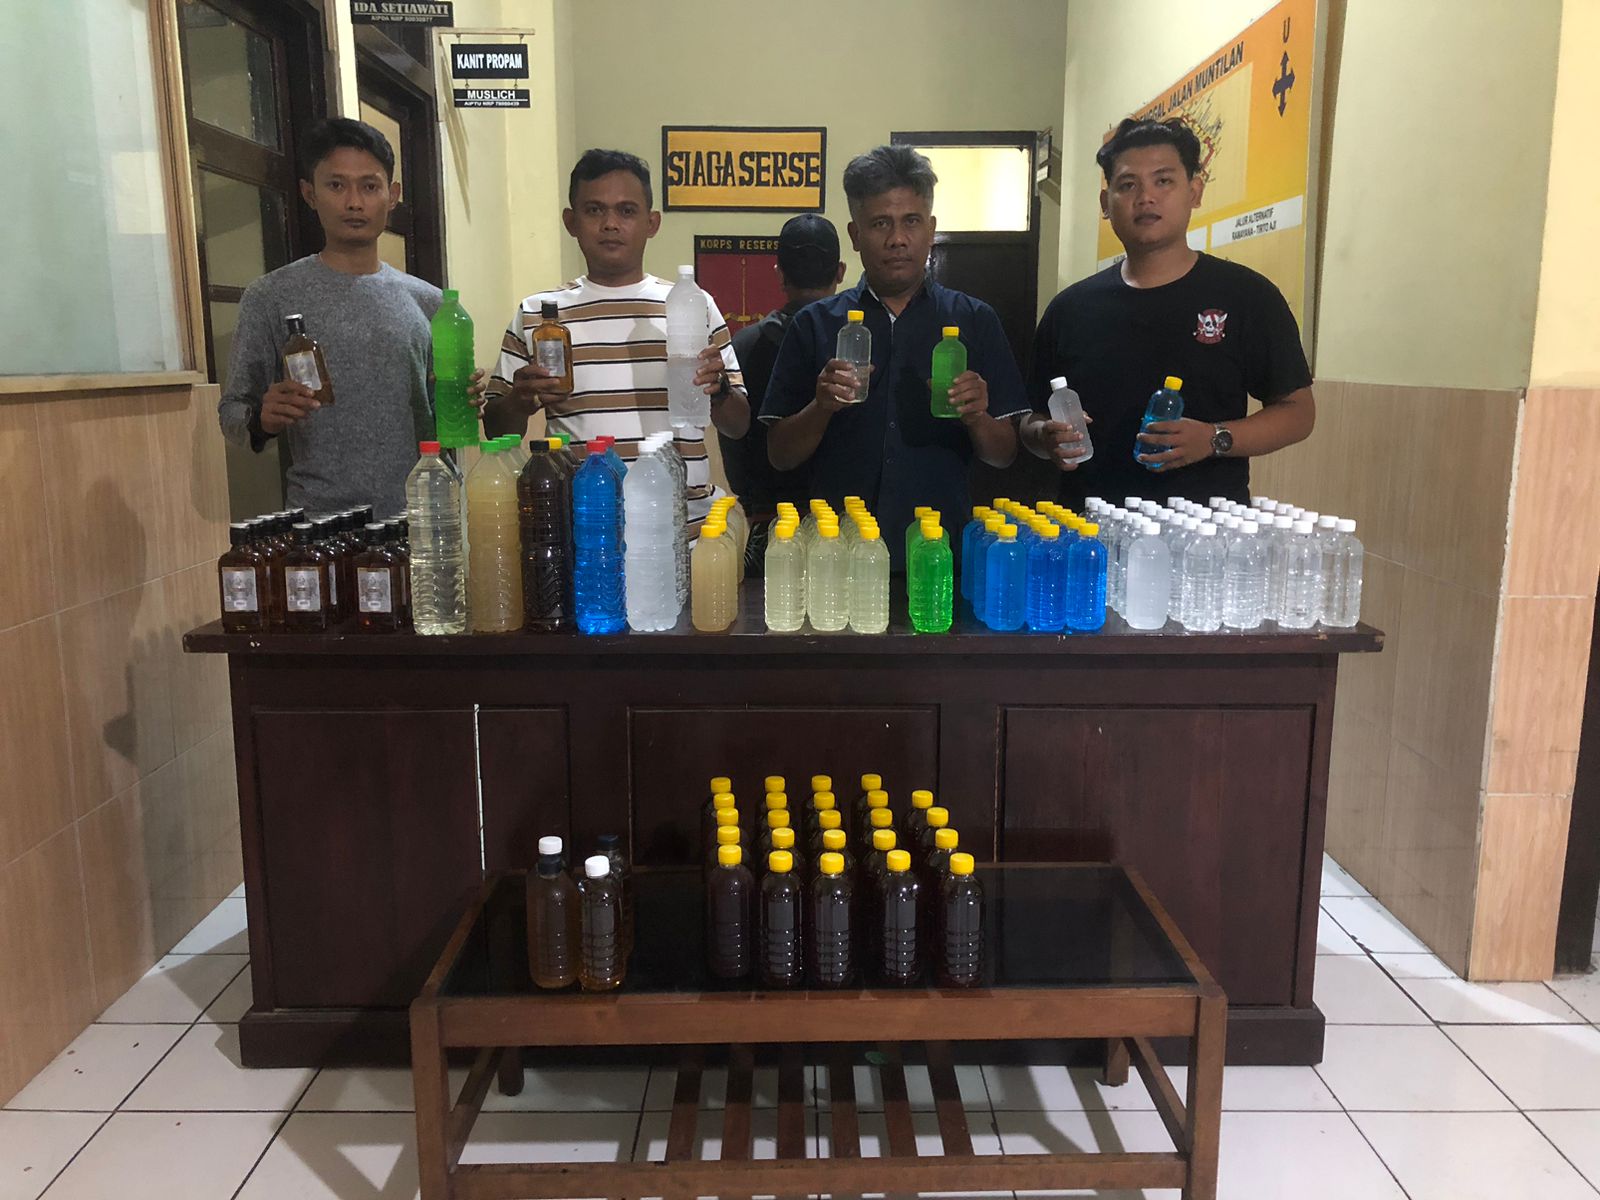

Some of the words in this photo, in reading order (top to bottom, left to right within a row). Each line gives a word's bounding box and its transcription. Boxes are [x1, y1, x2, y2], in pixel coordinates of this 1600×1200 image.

[354, 2, 378, 13] IDA
[381, 2, 449, 15] SETIAWATI
[1281, 16, 1291, 44] U
[456, 53, 485, 69] KANIT
[486, 53, 523, 69] PROPAM
[1168, 79, 1193, 113] JALAN
[1194, 41, 1244, 95] MUNTILAN
[467, 90, 515, 99] MUSLICH
[668, 151, 735, 186] SIAGA
[738, 151, 821, 187] SERSE
[700, 239, 733, 250] KORPS
